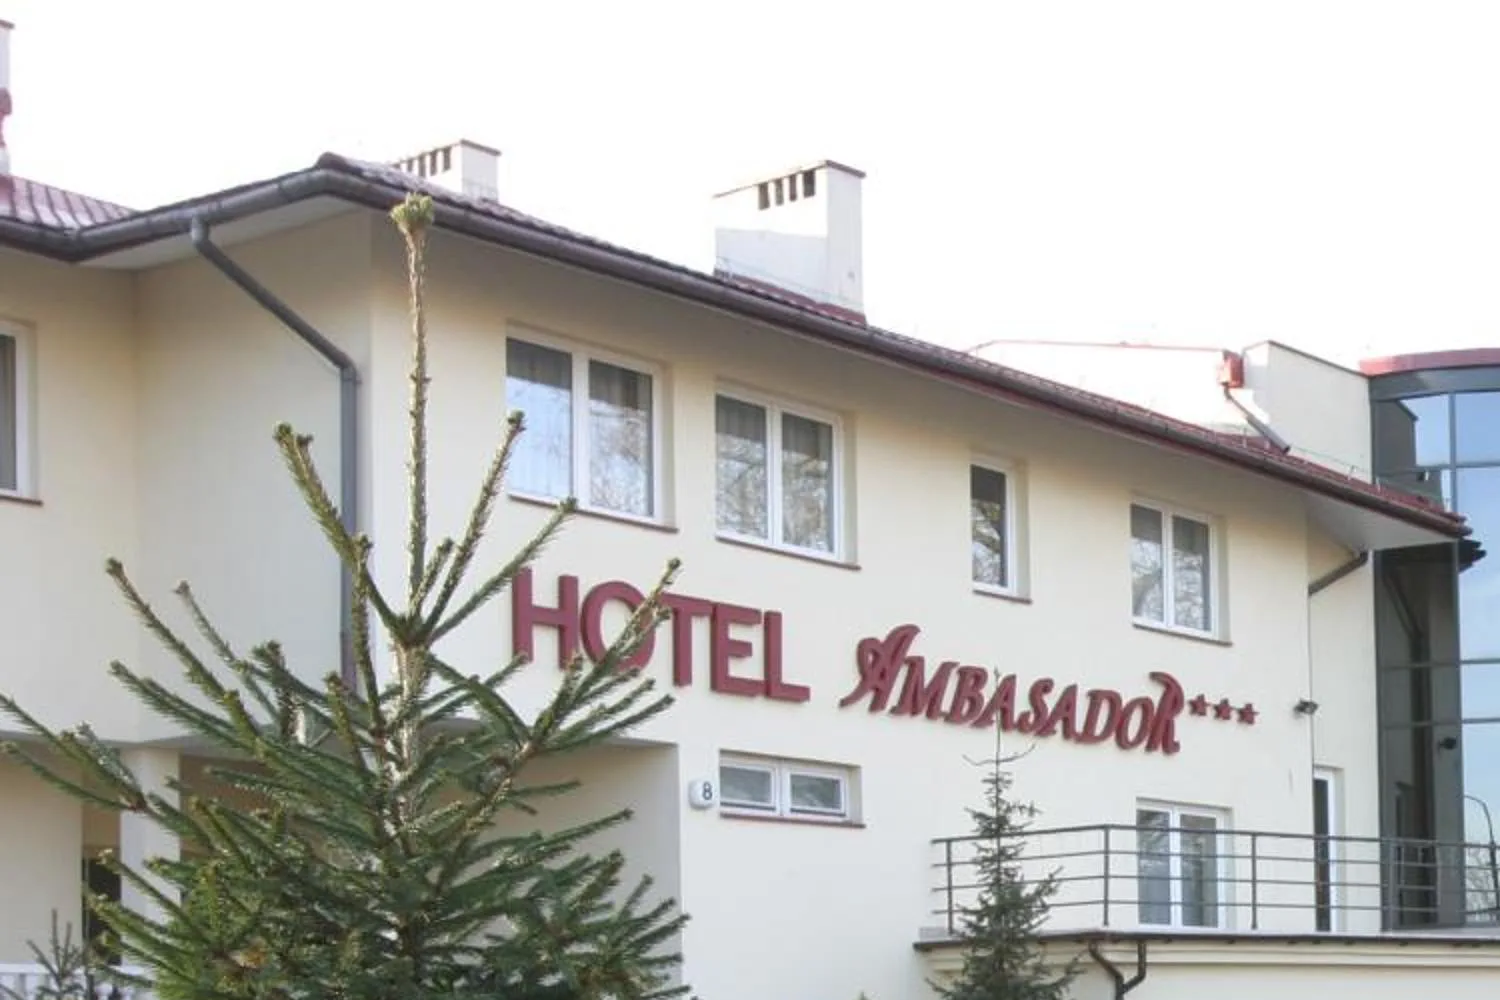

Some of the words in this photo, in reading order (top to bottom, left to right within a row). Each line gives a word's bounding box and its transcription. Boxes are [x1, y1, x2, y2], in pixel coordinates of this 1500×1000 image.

[511, 566, 811, 702] HOTEL
[838, 623, 1184, 755] AMBASADOR
[702, 781, 713, 801] 8
